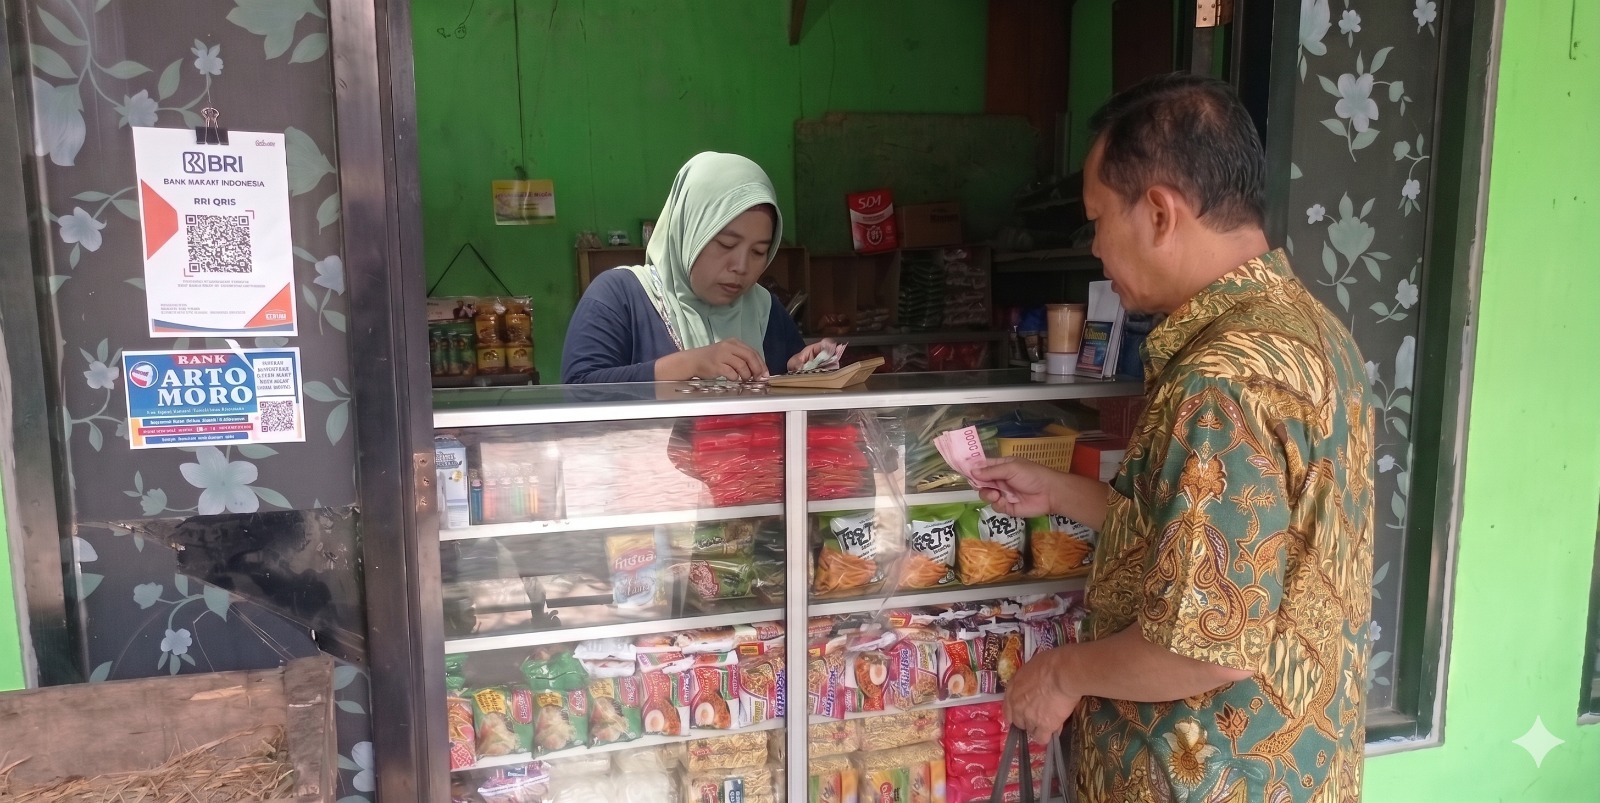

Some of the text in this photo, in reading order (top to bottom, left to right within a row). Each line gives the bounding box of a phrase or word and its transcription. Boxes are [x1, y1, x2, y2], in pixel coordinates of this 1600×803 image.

[208, 155, 244, 173] BRI
[213, 198, 236, 206] QRIS
[161, 367, 247, 387] ARTO
[157, 385, 253, 407] MORO
